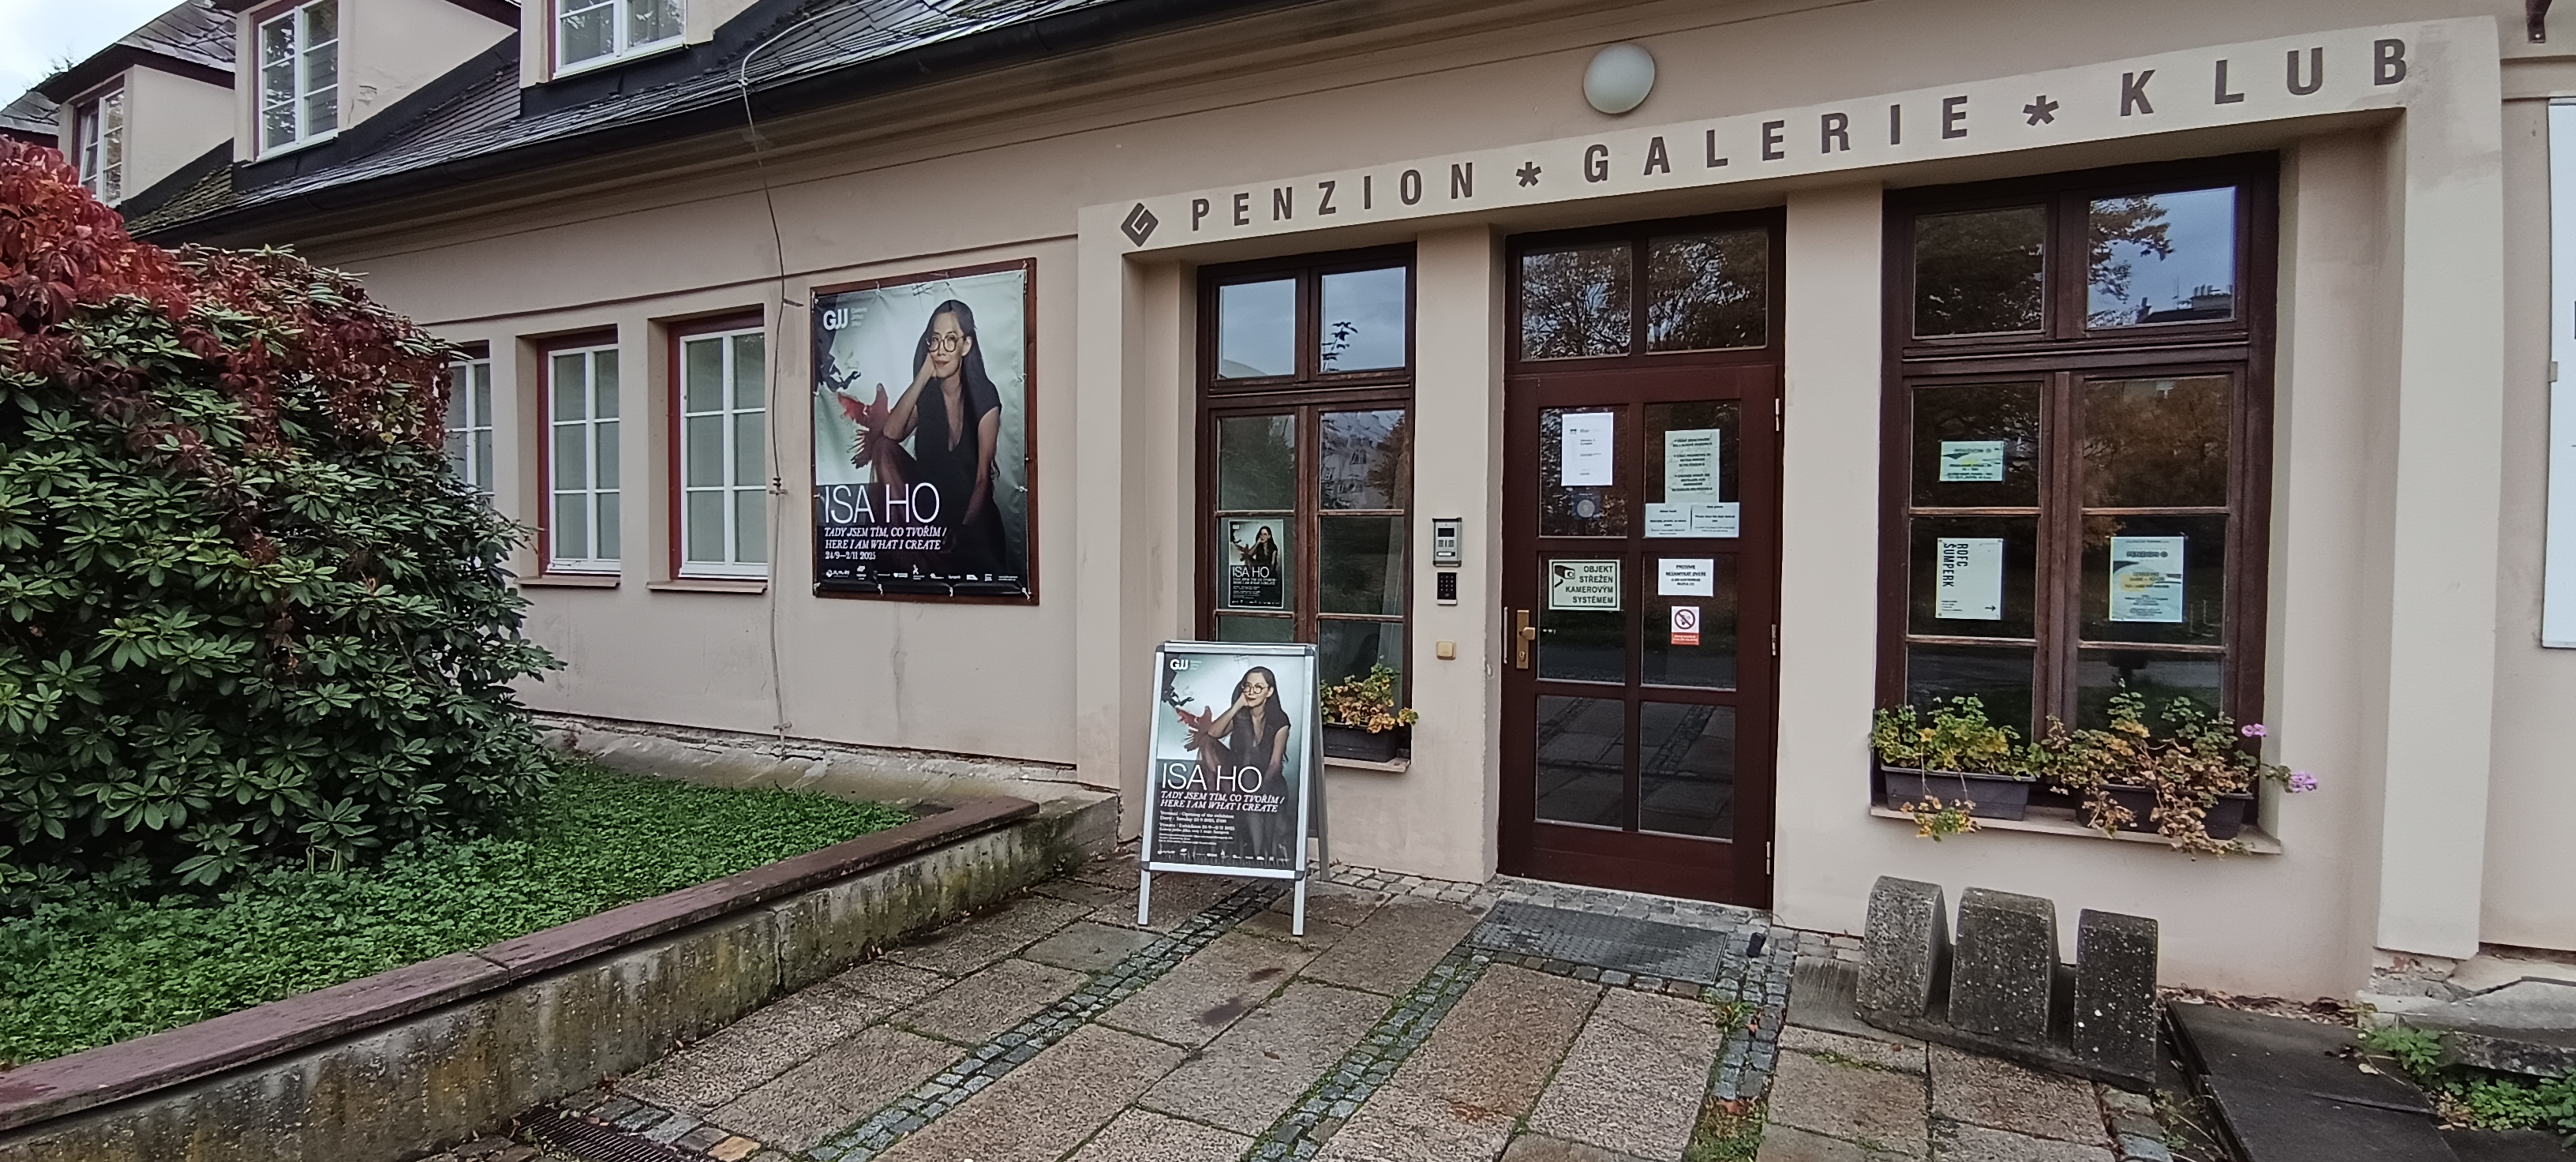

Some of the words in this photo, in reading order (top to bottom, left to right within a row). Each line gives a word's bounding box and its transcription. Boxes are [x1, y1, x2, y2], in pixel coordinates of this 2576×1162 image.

[1192, 162, 1473, 231] PENZION
[1583, 96, 1968, 183] GALERIE
[2120, 38, 2408, 117] KLUB
[823, 308, 848, 331] GJJ
[825, 485, 875, 523] ISA
[886, 482, 940, 523] HO
[824, 527, 847, 537] TADY
[847, 527, 868, 537] JSEM
[870, 526, 889, 538] TÍM,
[890, 527, 904, 537] CO
[906, 525, 942, 537] TVOŘÍM
[825, 539, 848, 549] HERE
[849, 539, 854, 549] I
[855, 539, 869, 549] AM
[871, 539, 899, 549] WHAT
[899, 539, 904, 549] I
[905, 539, 941, 550] CREATE
[859, 551, 876, 560] 2025
[1956, 543, 1968, 567] ROFC
[1942, 542, 1956, 587] ŠUMPERK
[1232, 566, 1249, 578] ISA
[1252, 566, 1270, 578] HO
[1579, 574, 1613, 583] STŘEŽEN
[1170, 658, 1189, 670] GJJ
[1162, 763, 1208, 790] ISA
[1216, 765, 1263, 793] HO
[1160, 790, 1185, 799] TADY
[1184, 792, 1208, 800] JSEM
[1208, 793, 1227, 802] TÍM,
[1244, 794, 1279, 804] TVOŘÍM
[1159, 799, 1185, 808] HERE
[1186, 800, 1192, 808] I
[1192, 800, 1208, 809] AM
[1208, 801, 1236, 810] WHAT
[1236, 802, 1241, 811] I
[1241, 803, 1279, 812] CREATE
